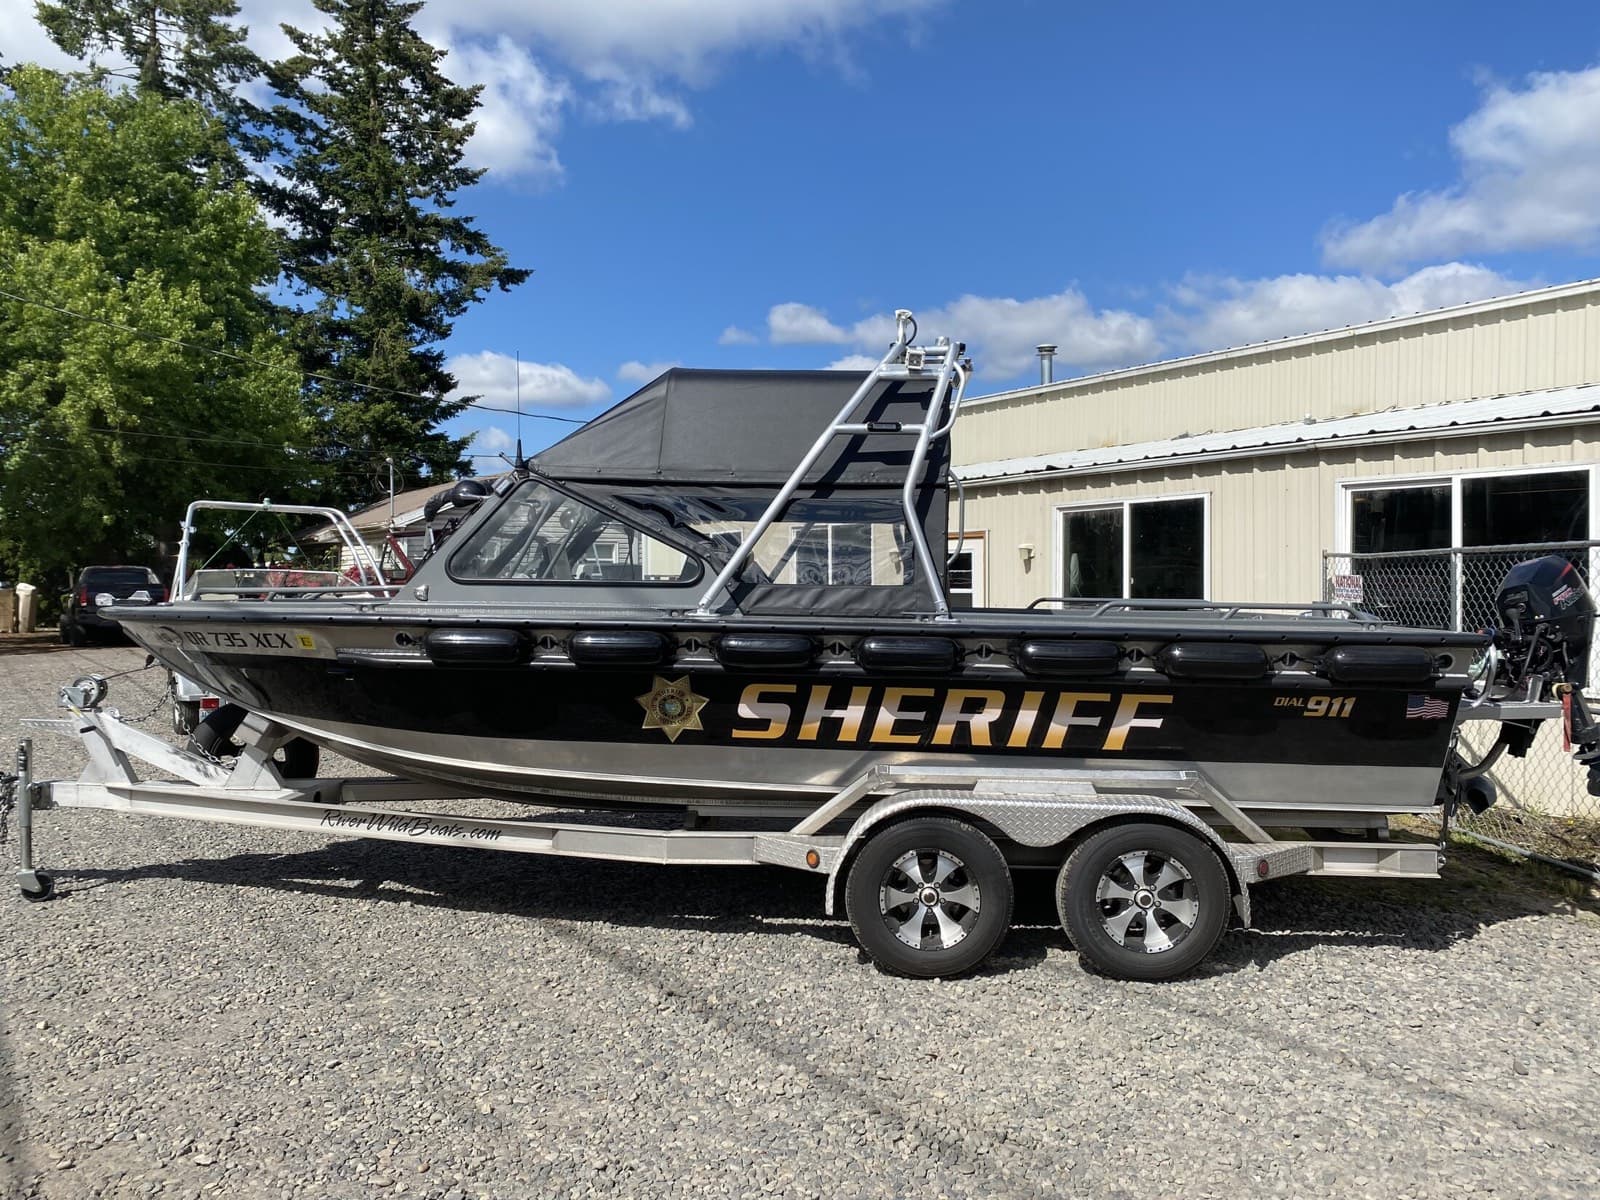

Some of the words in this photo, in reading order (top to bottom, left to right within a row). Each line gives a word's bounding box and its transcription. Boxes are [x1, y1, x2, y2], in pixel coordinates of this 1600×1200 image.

[208, 632, 248, 647] 735
[250, 632, 293, 649] XCX
[731, 683, 1174, 751] SHERIFF
[1273, 696, 1305, 707] DIAL
[1303, 695, 1357, 718] 911
[320, 808, 502, 842] RiverWildBoats.com
